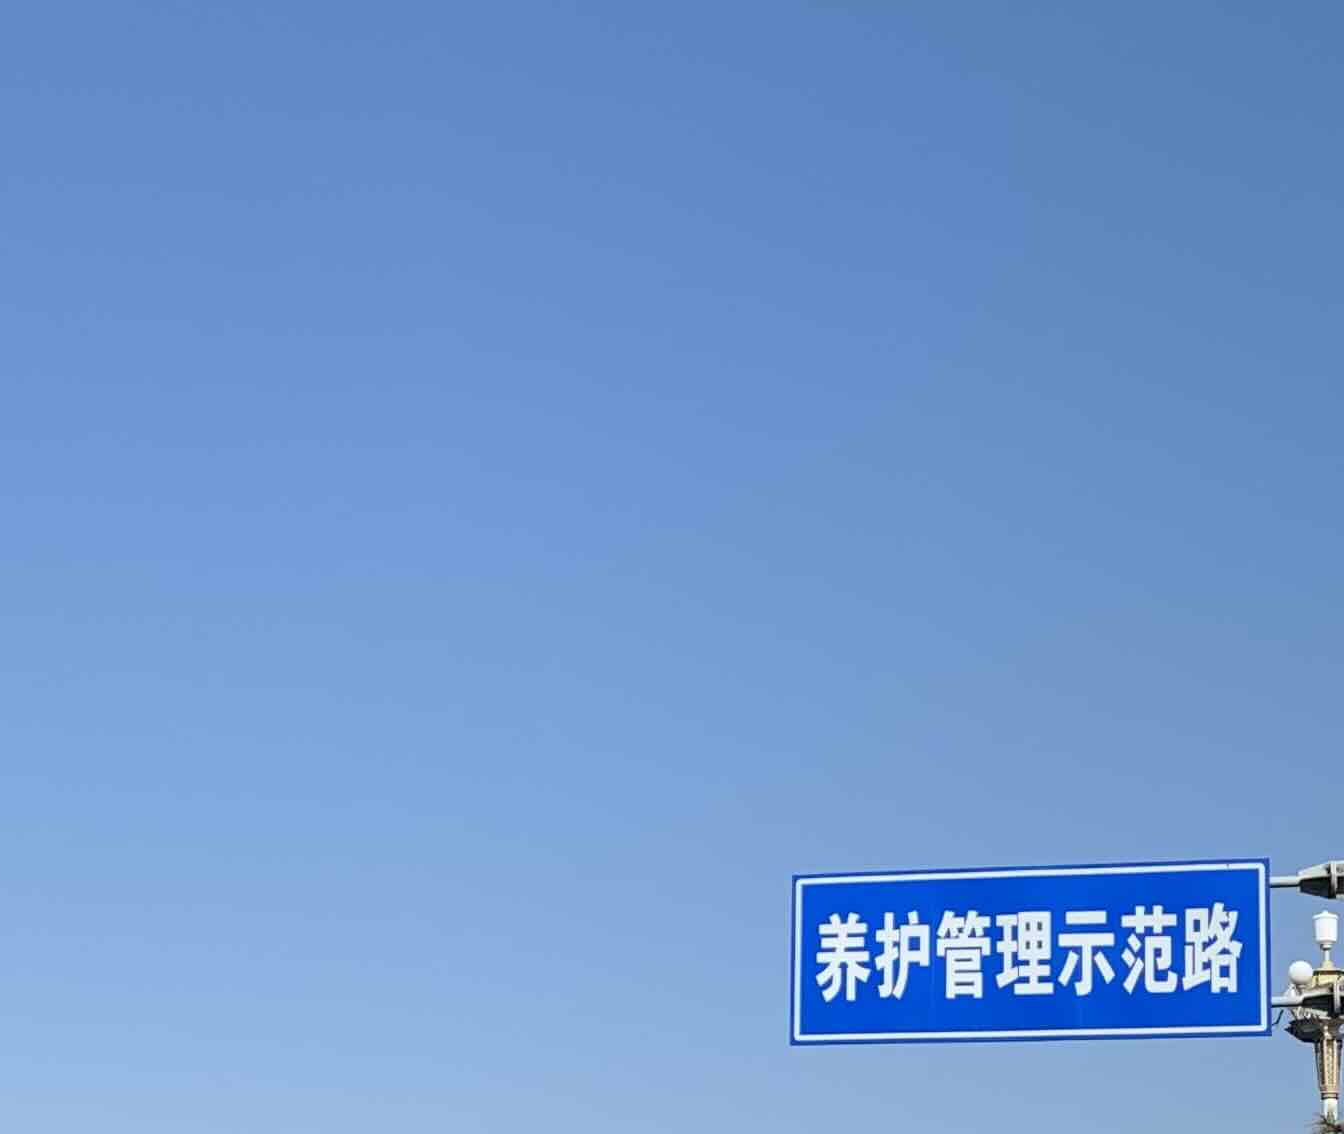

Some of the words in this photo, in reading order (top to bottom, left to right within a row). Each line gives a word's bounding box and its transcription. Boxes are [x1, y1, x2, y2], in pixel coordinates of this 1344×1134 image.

[815, 902, 1243, 1002] 养护管理示范路
